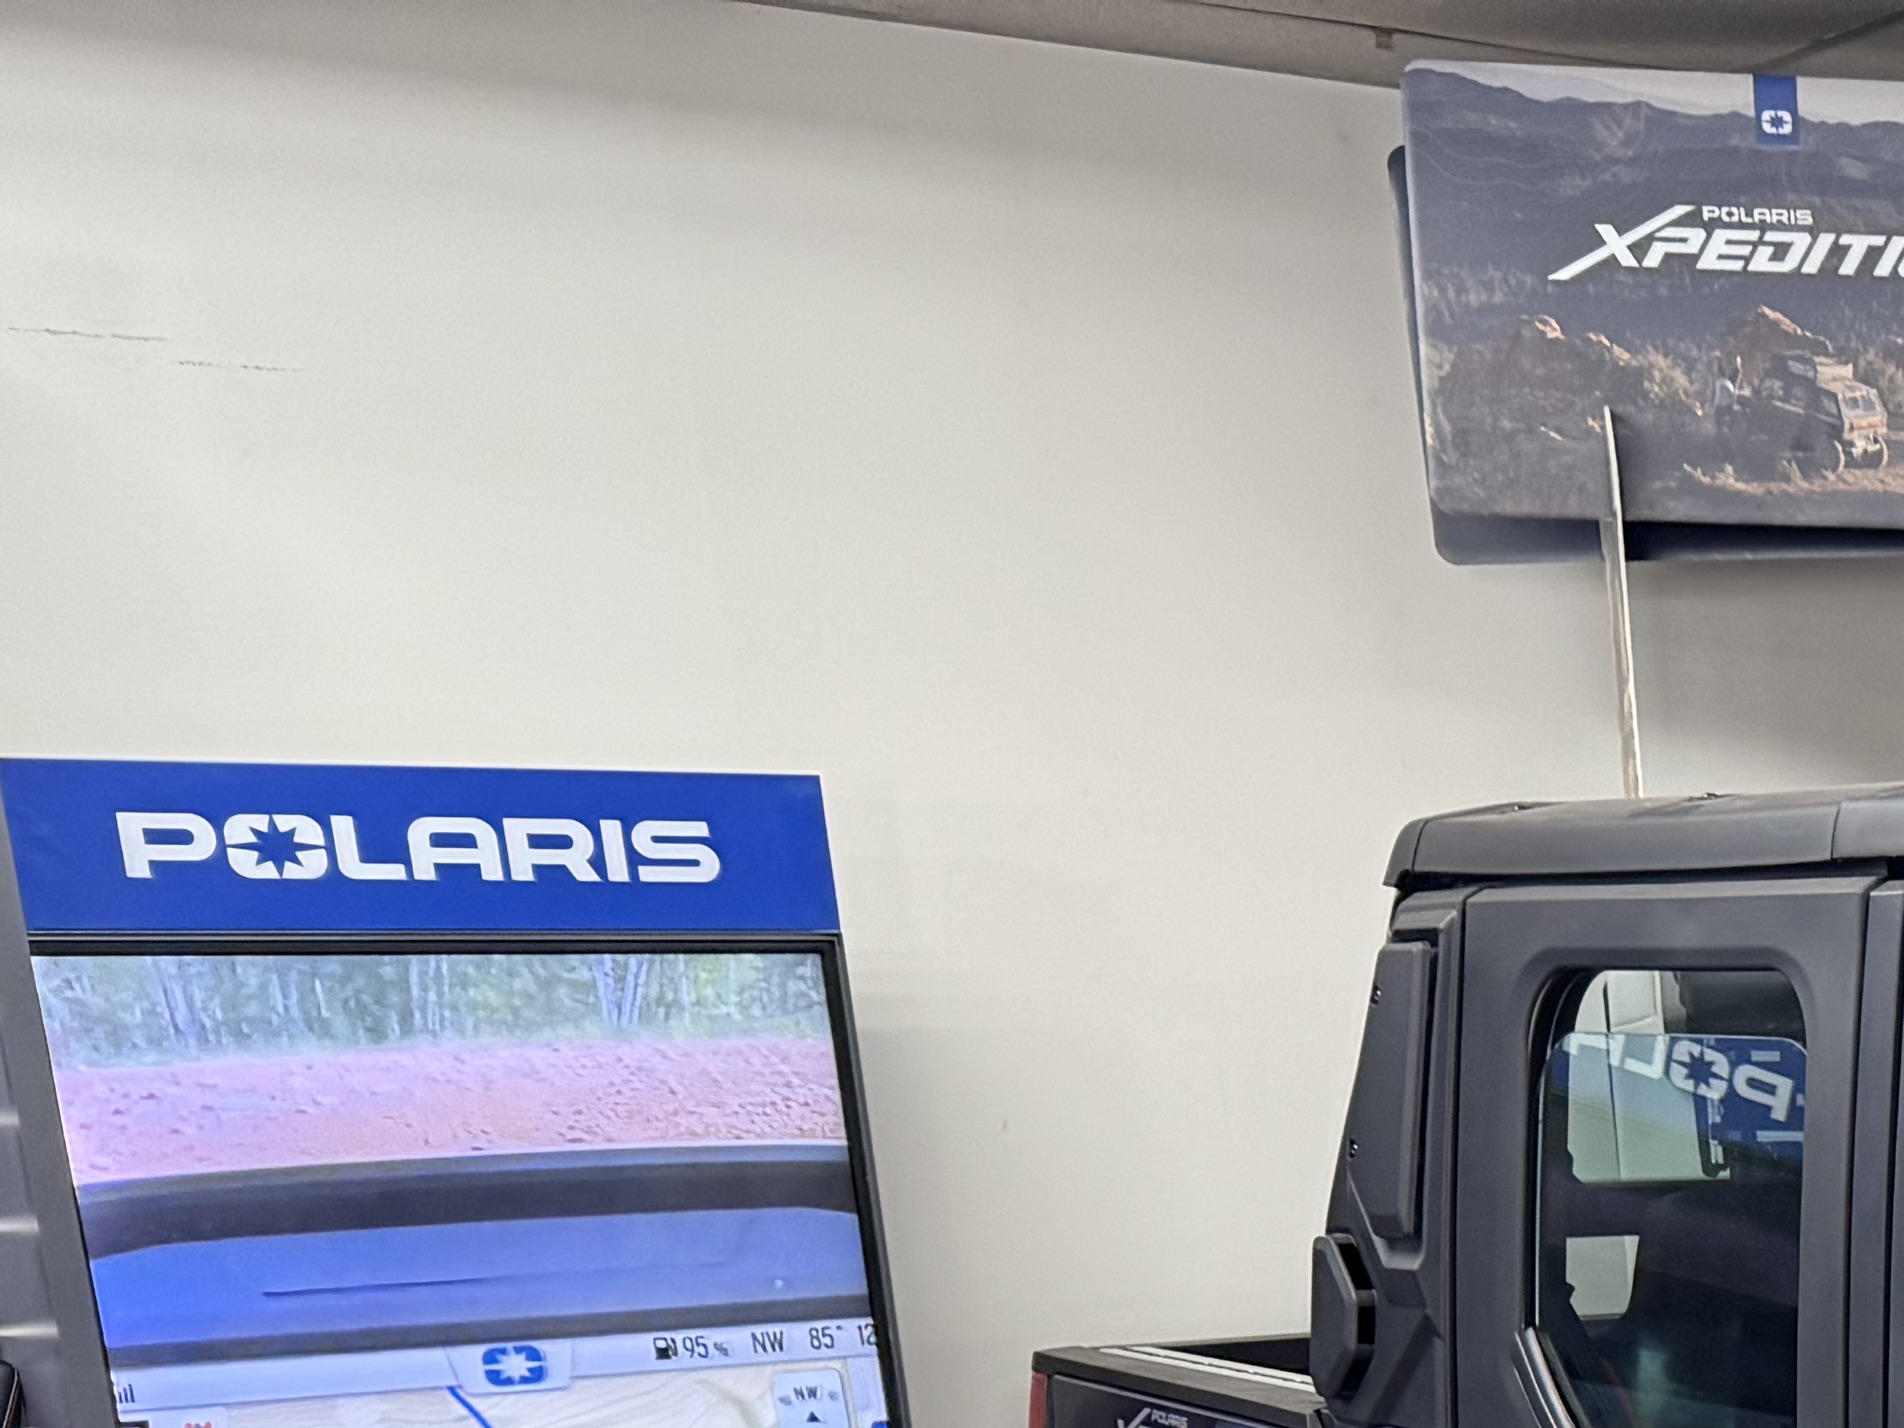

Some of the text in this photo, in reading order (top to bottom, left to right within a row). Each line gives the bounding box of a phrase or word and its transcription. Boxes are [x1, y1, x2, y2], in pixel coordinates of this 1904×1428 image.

[1702, 204, 1813, 226] POLARIS
[115, 811, 721, 884] POLARIS
[751, 1330, 784, 1354] NW
